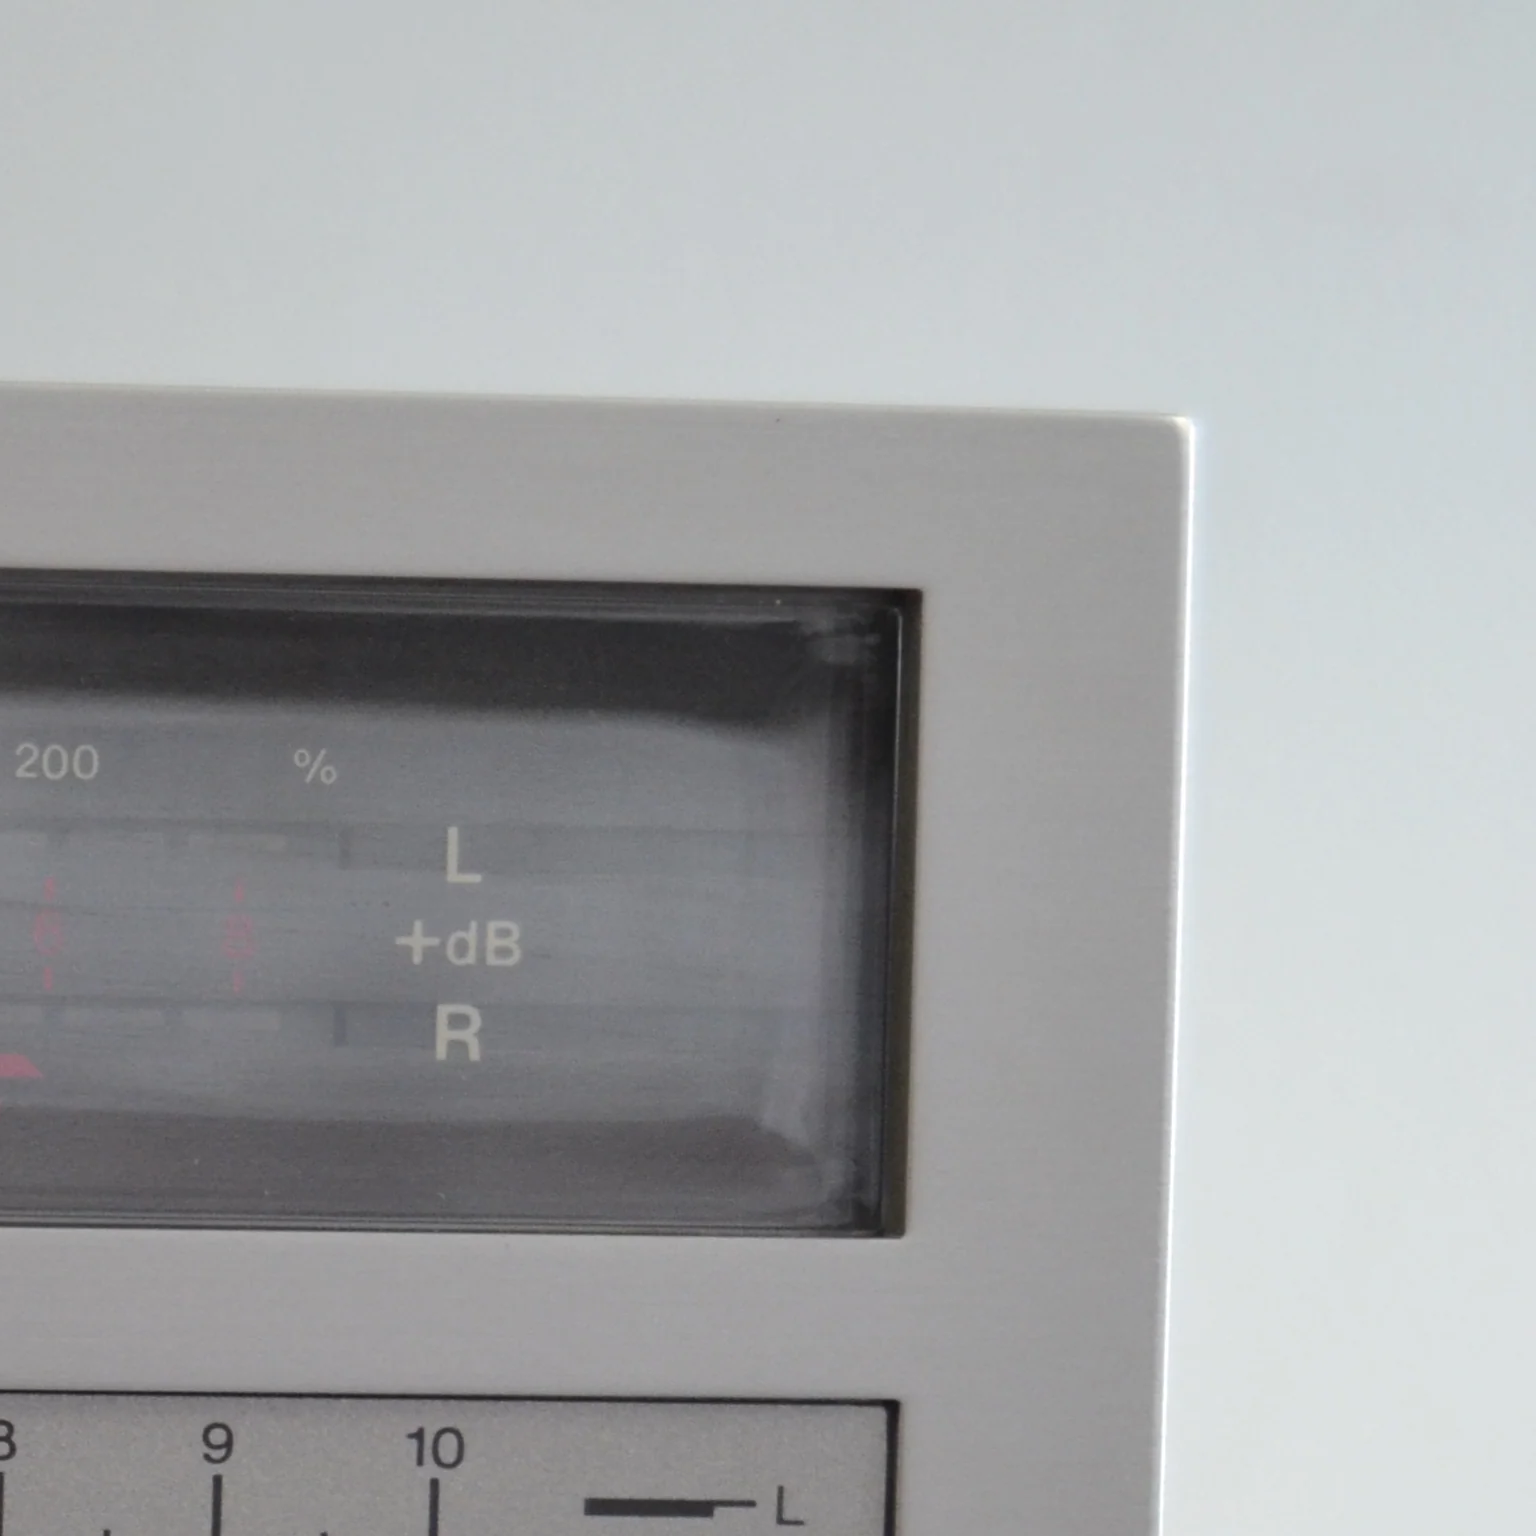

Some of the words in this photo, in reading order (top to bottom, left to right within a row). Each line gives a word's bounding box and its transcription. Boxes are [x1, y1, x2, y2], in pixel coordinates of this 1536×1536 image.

[14, 742, 100, 781] 200
[293, 748, 339, 786] %
[445, 825, 483, 885] L
[395, 919, 522, 967] +dB
[435, 1003, 483, 1062] R
[201, 1421, 234, 1465] 9
[406, 1426, 466, 1470] 10
[775, 1485, 806, 1527] L
